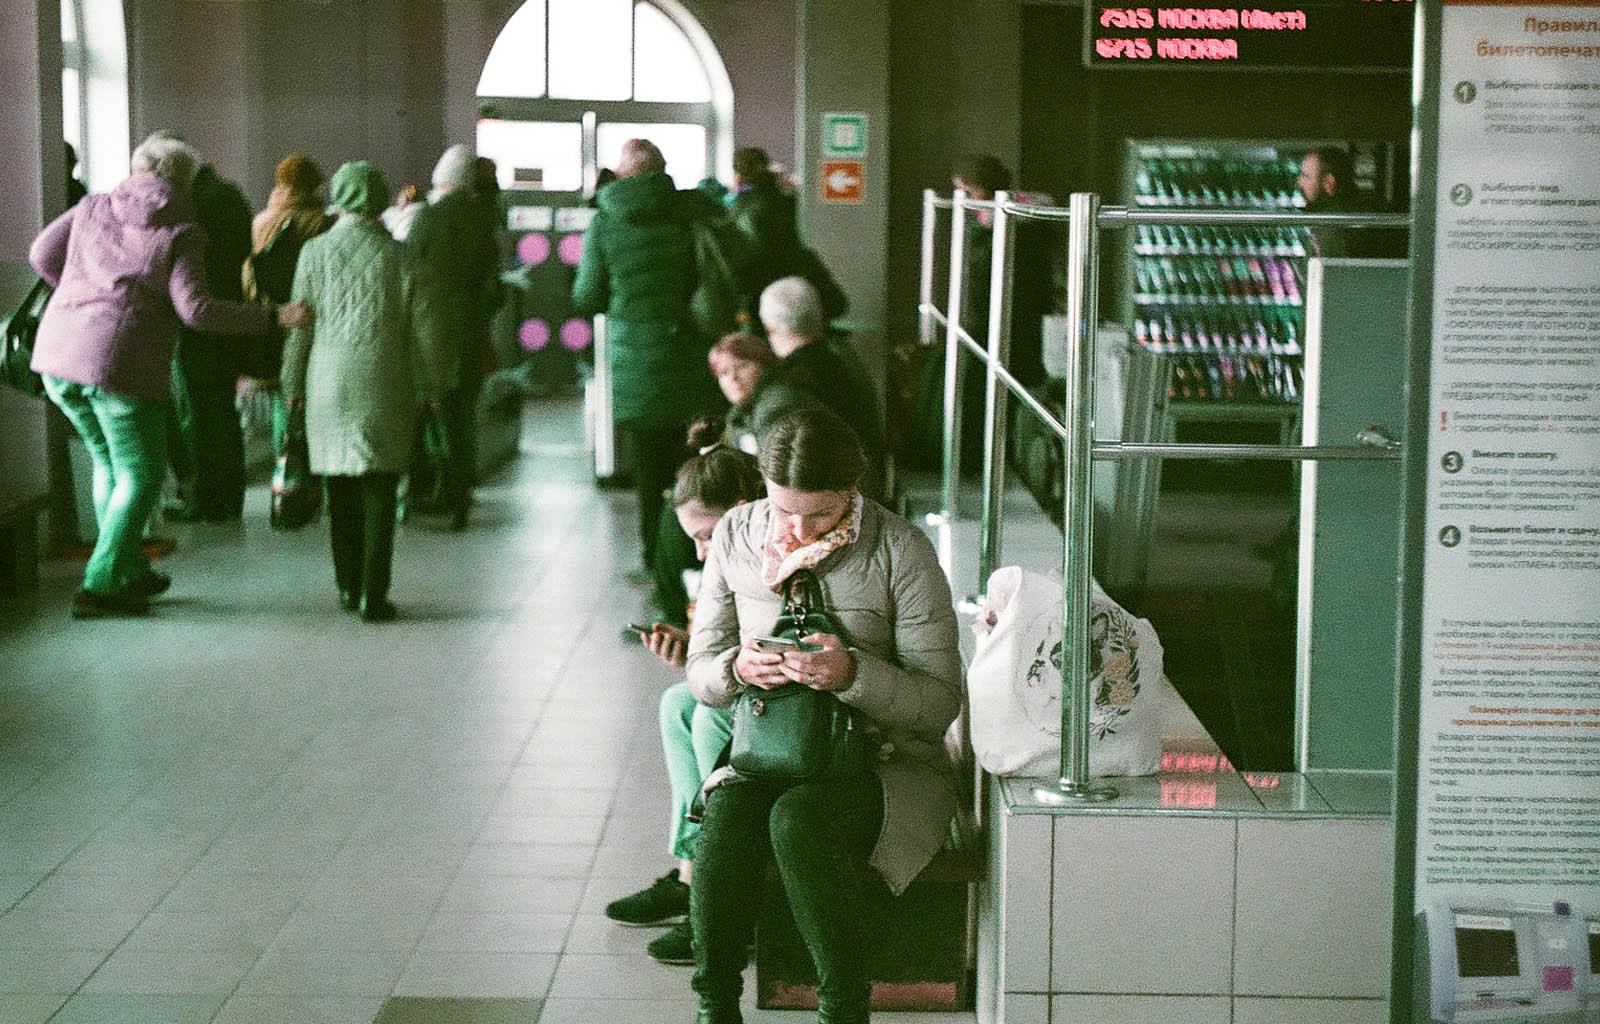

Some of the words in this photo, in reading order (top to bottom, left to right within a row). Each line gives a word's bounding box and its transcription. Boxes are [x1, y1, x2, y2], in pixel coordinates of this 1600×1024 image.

[1157, 8, 1239, 30] МОСКВА
[1156, 38, 1238, 60] МОСКВА
[1472, 450, 1515, 459] Внесите
